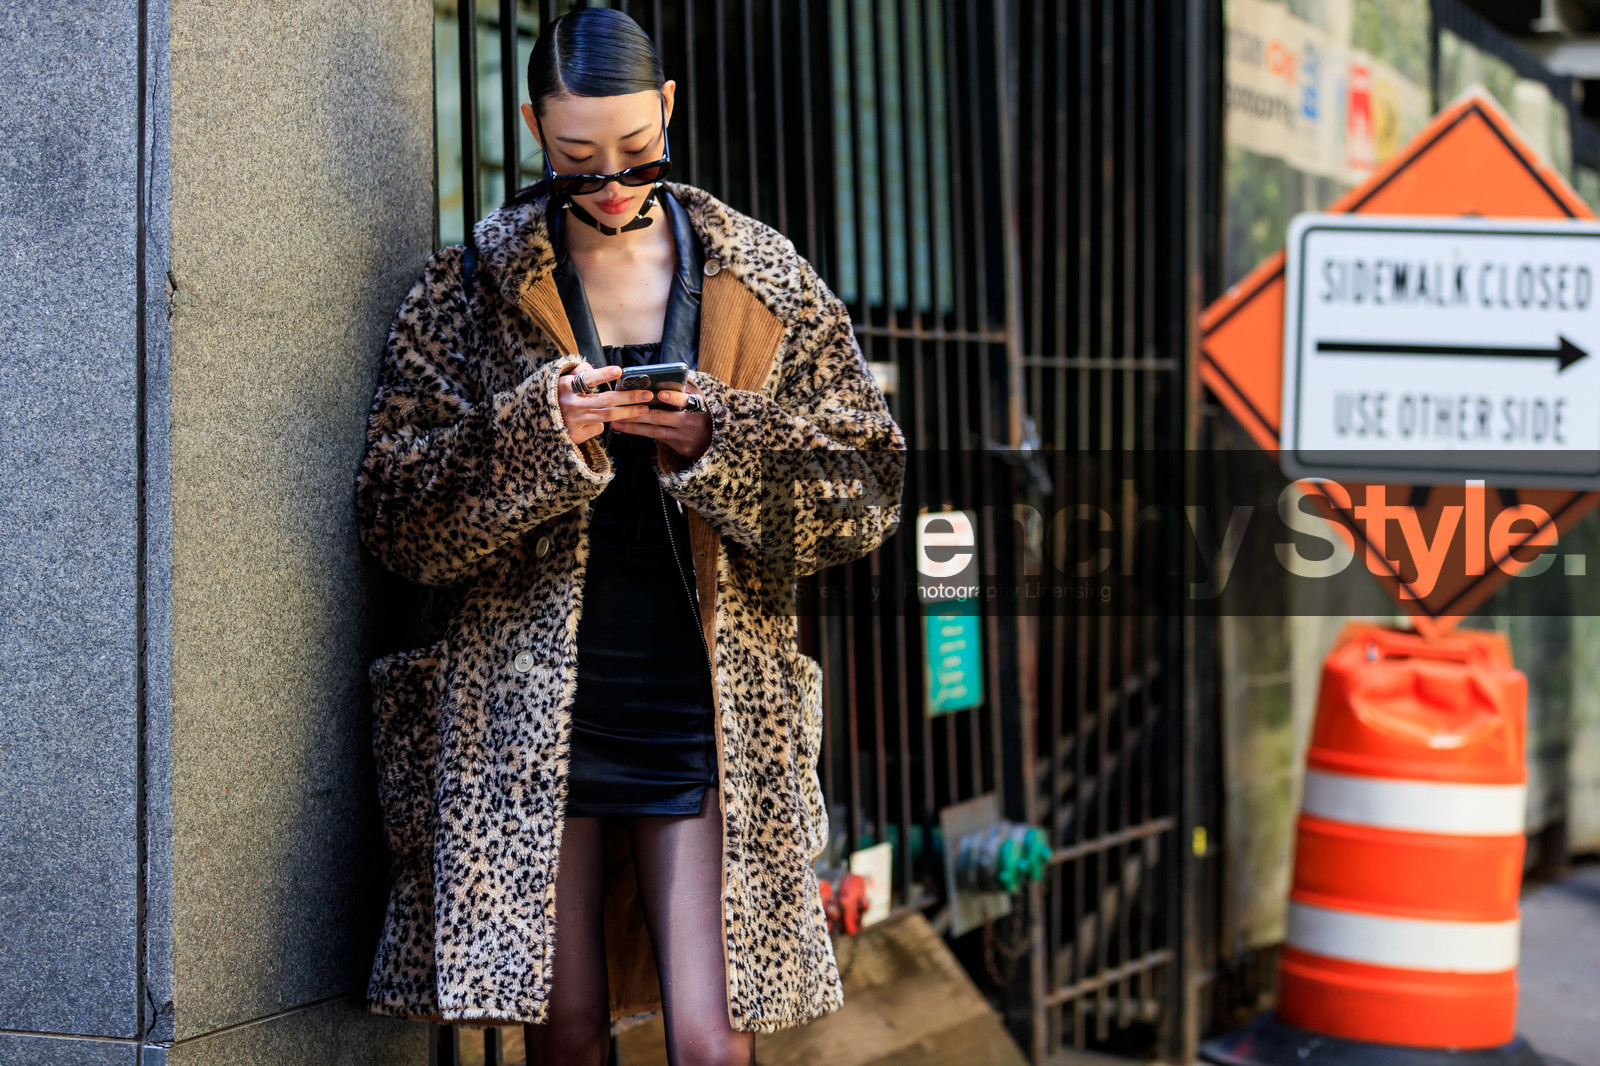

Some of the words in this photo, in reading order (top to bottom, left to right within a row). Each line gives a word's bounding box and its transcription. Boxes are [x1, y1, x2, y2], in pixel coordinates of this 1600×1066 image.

[1320, 258, 1470, 307] SIDEWALK
[1478, 262, 1593, 311] CLOSED
[1334, 391, 1389, 438] USE
[1398, 392, 1492, 441] OTHER
[1500, 397, 1567, 444] SIDE
